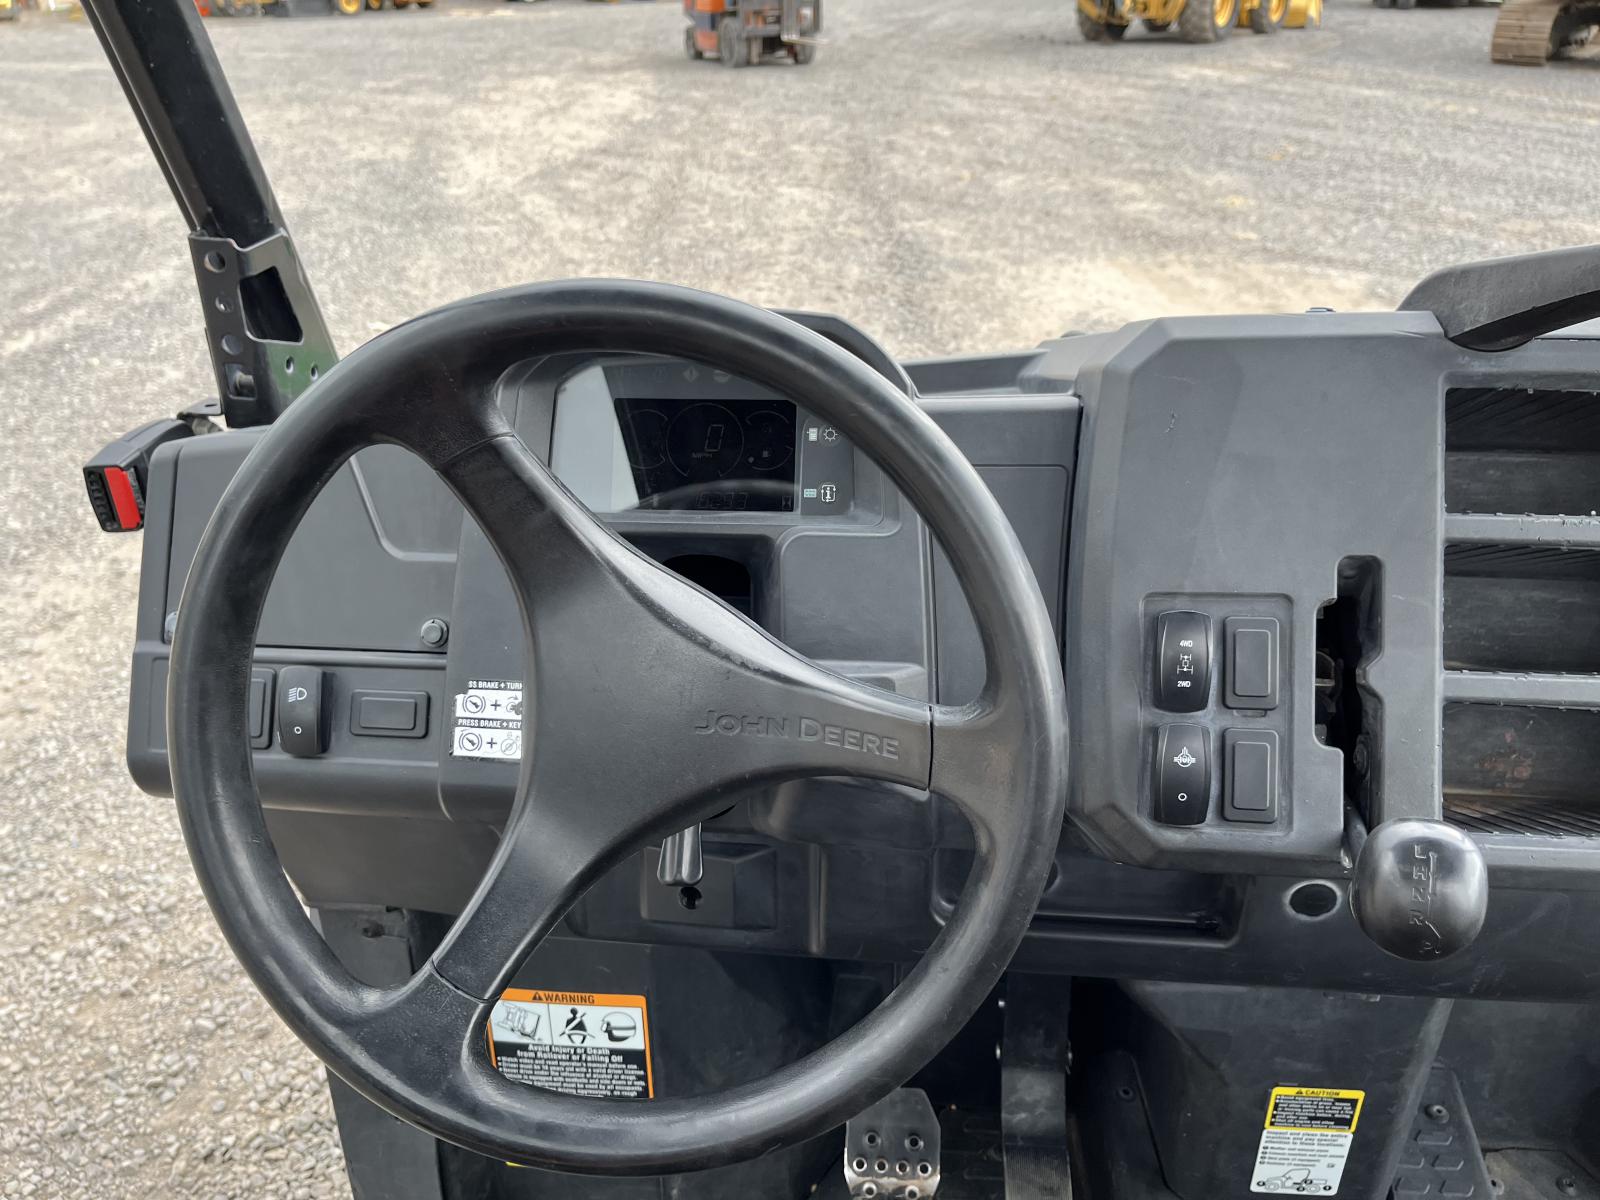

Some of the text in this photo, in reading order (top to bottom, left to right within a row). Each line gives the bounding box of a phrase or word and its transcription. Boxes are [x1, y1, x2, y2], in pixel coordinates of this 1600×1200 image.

[695, 709, 900, 760] JOHN DEERE
[544, 992, 595, 1004] WARNING
[552, 1045, 574, 1054] Injury
[517, 1050, 535, 1058] from
[536, 1051, 569, 1060] Rollover
[582, 1054, 609, 1063] Falling
